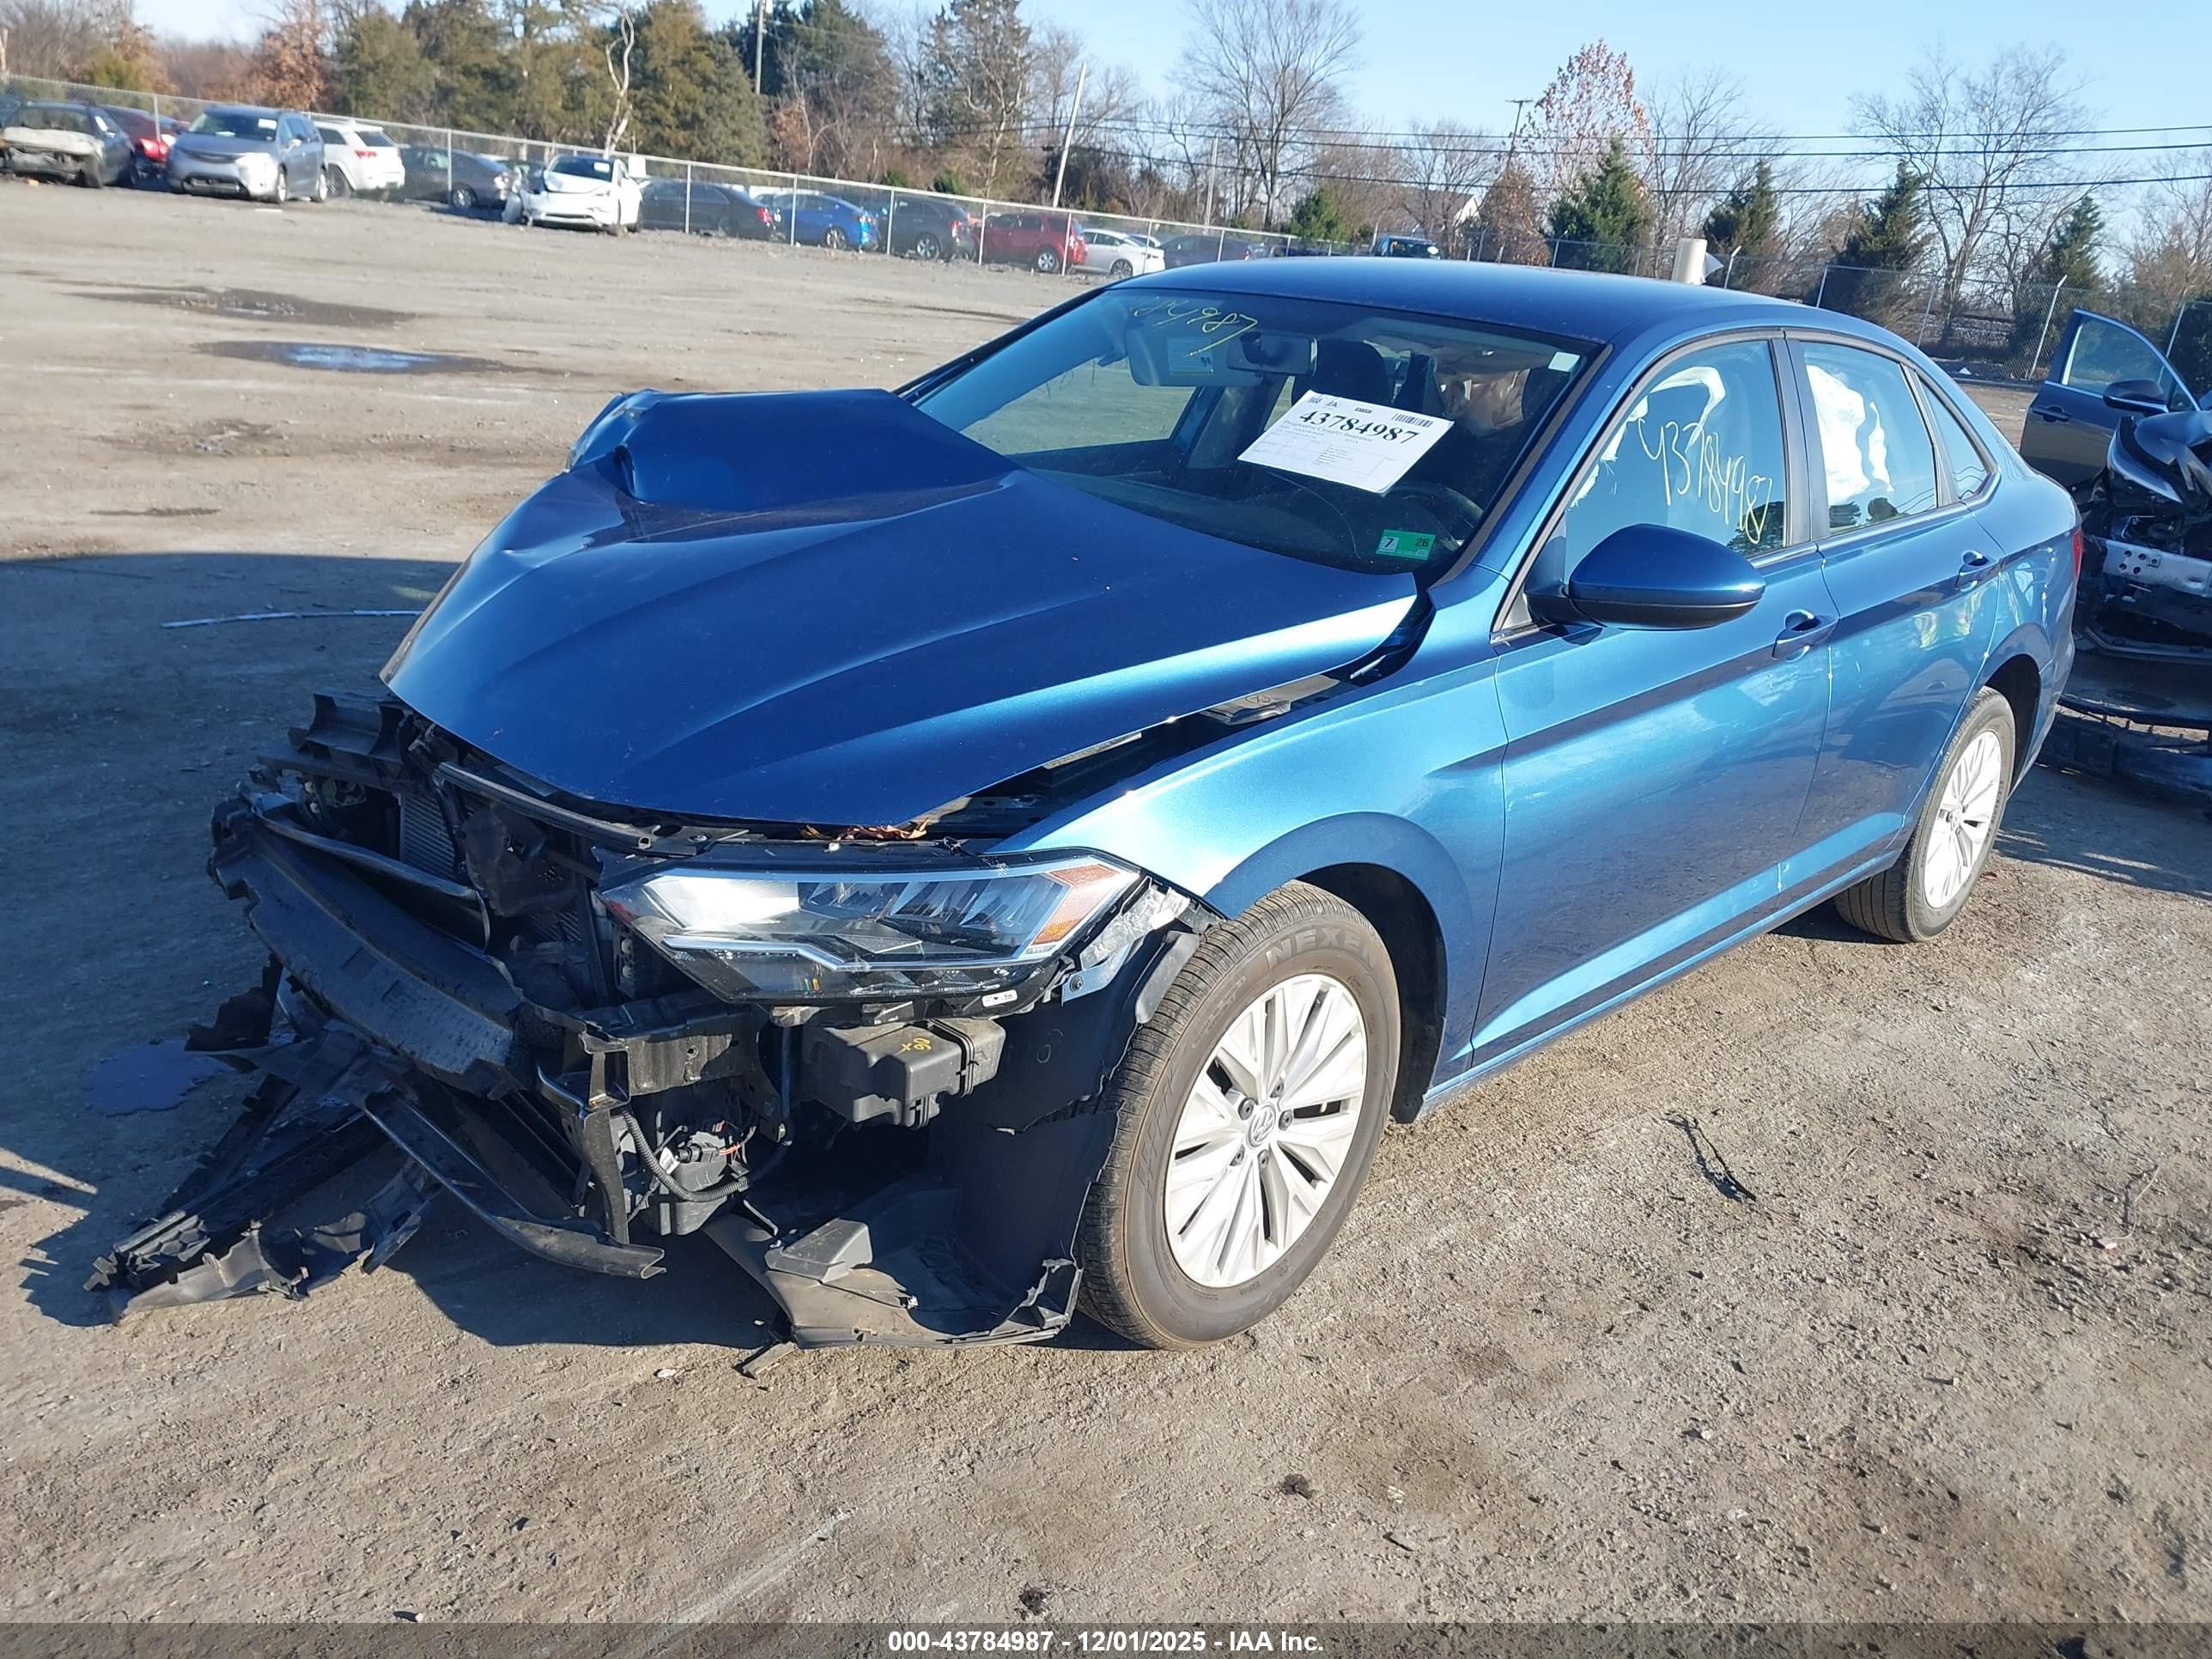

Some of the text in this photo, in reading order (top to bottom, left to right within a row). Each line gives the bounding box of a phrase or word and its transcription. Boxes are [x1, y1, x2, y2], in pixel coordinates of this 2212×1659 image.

[1299, 410, 1420, 444] 43784987
[1638, 418, 1773, 544] 43784987
[1384, 537, 1430, 548] 7 26
